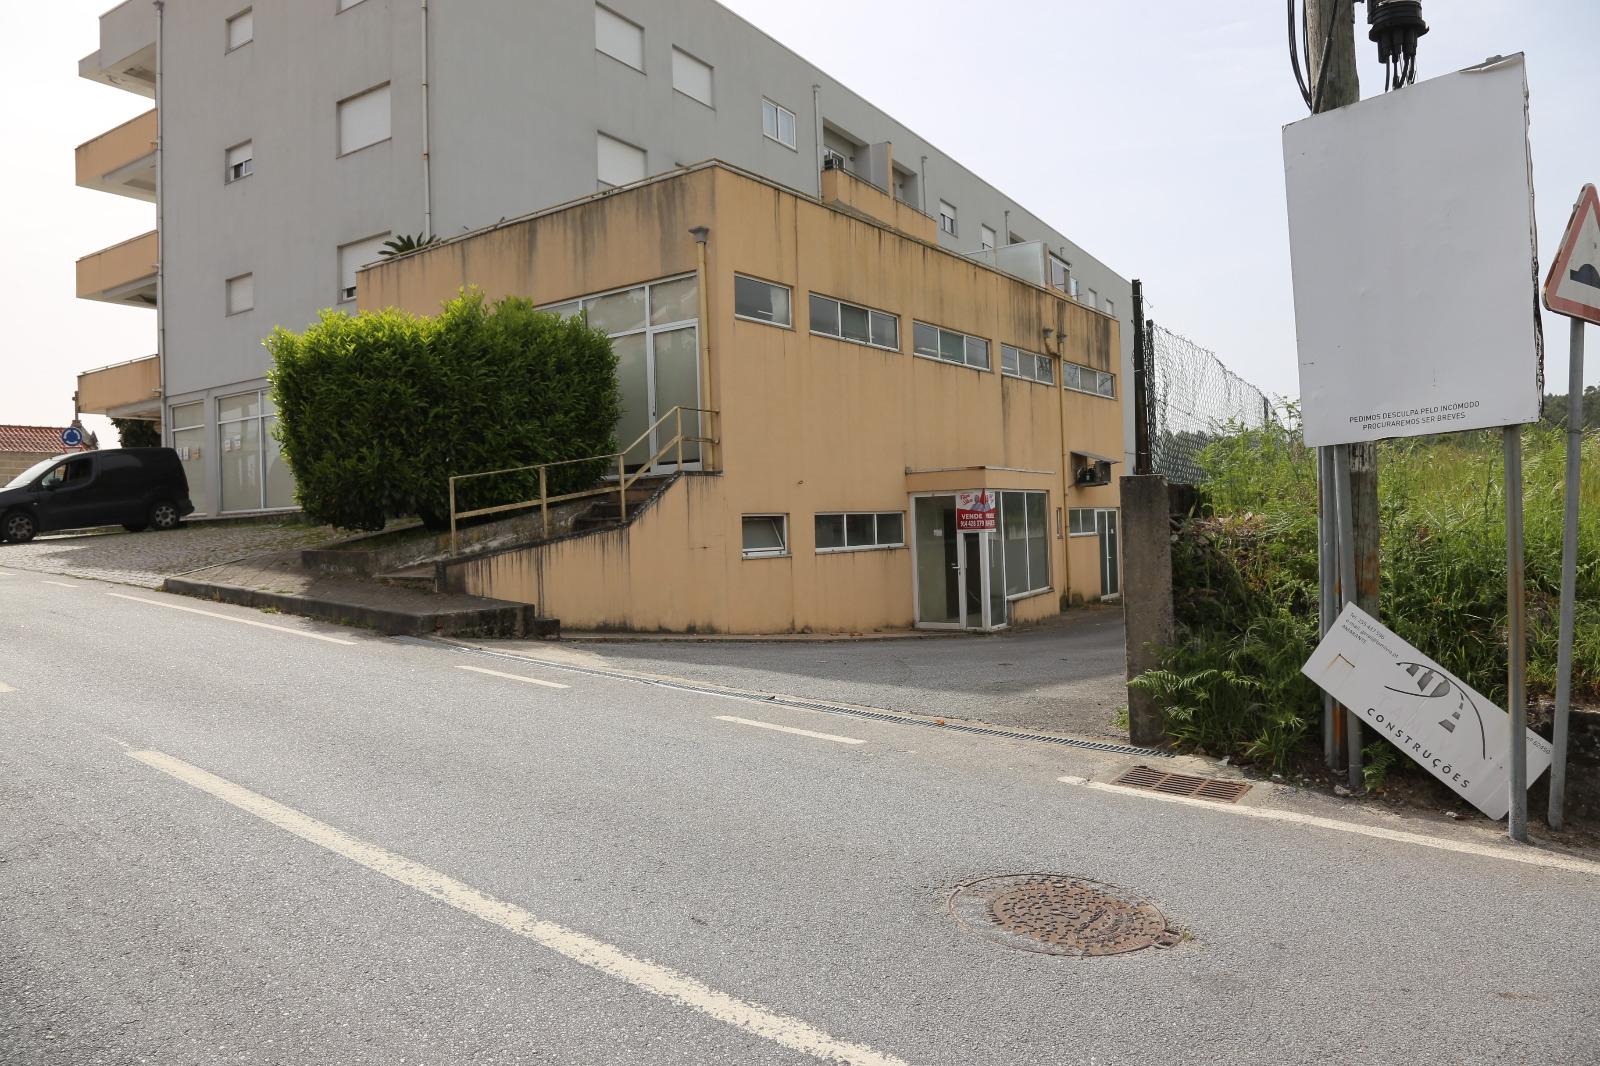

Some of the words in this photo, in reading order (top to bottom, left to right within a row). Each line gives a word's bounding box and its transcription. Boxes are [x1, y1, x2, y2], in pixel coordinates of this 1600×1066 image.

[1349, 414, 1381, 423] PEDIMOS
[1382, 409, 1419, 419] DESCULPA
[1420, 406, 1439, 415] PELO
[1362, 417, 1420, 431] PROCURAREMOS
[1421, 415, 1435, 424] SER
[1437, 411, 1466, 422] BREVES
[1367, 707, 1470, 789] CONSTRUÇÕES
